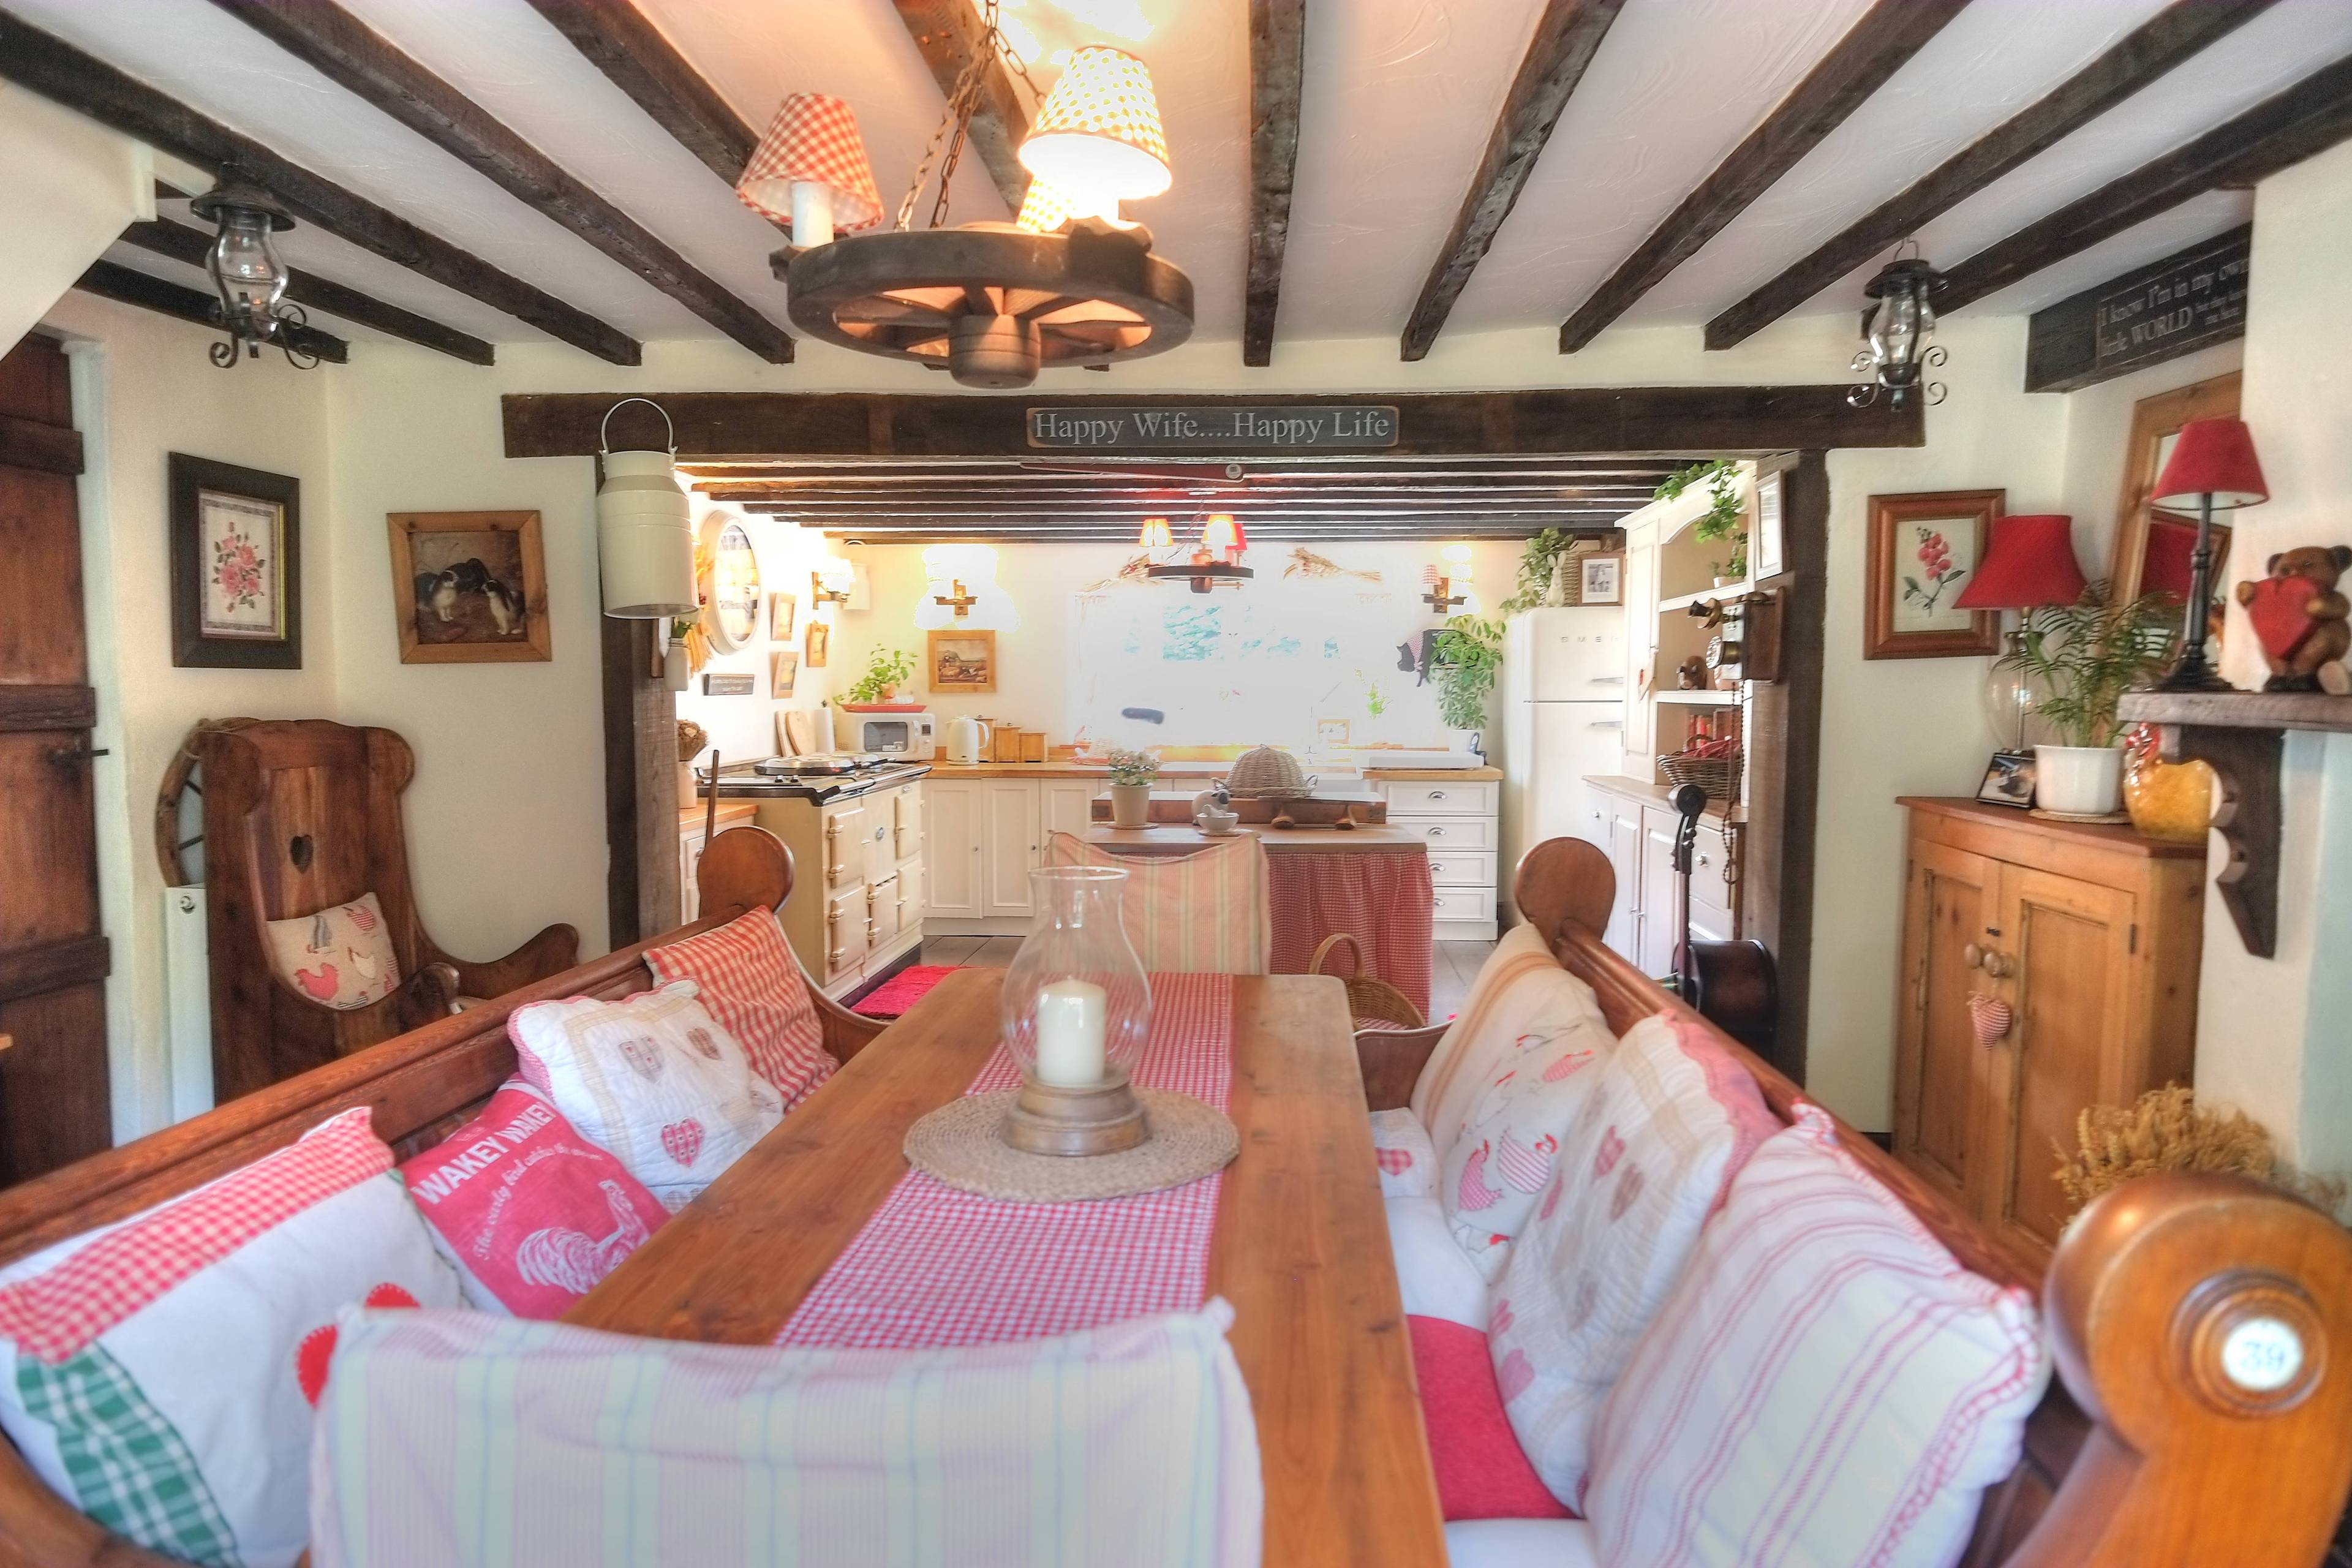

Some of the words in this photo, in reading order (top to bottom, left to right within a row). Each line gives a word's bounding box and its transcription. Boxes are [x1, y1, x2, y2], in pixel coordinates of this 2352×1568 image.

[2174, 277, 2189, 298] in
[2191, 271, 2215, 295] my
[2132, 306, 2192, 345] WORLD
[1034, 413, 1125, 445] Happy
[1332, 412, 1390, 437] Life
[410, 1136, 510, 1204] WAKEY
[502, 1159, 528, 1186] bird
